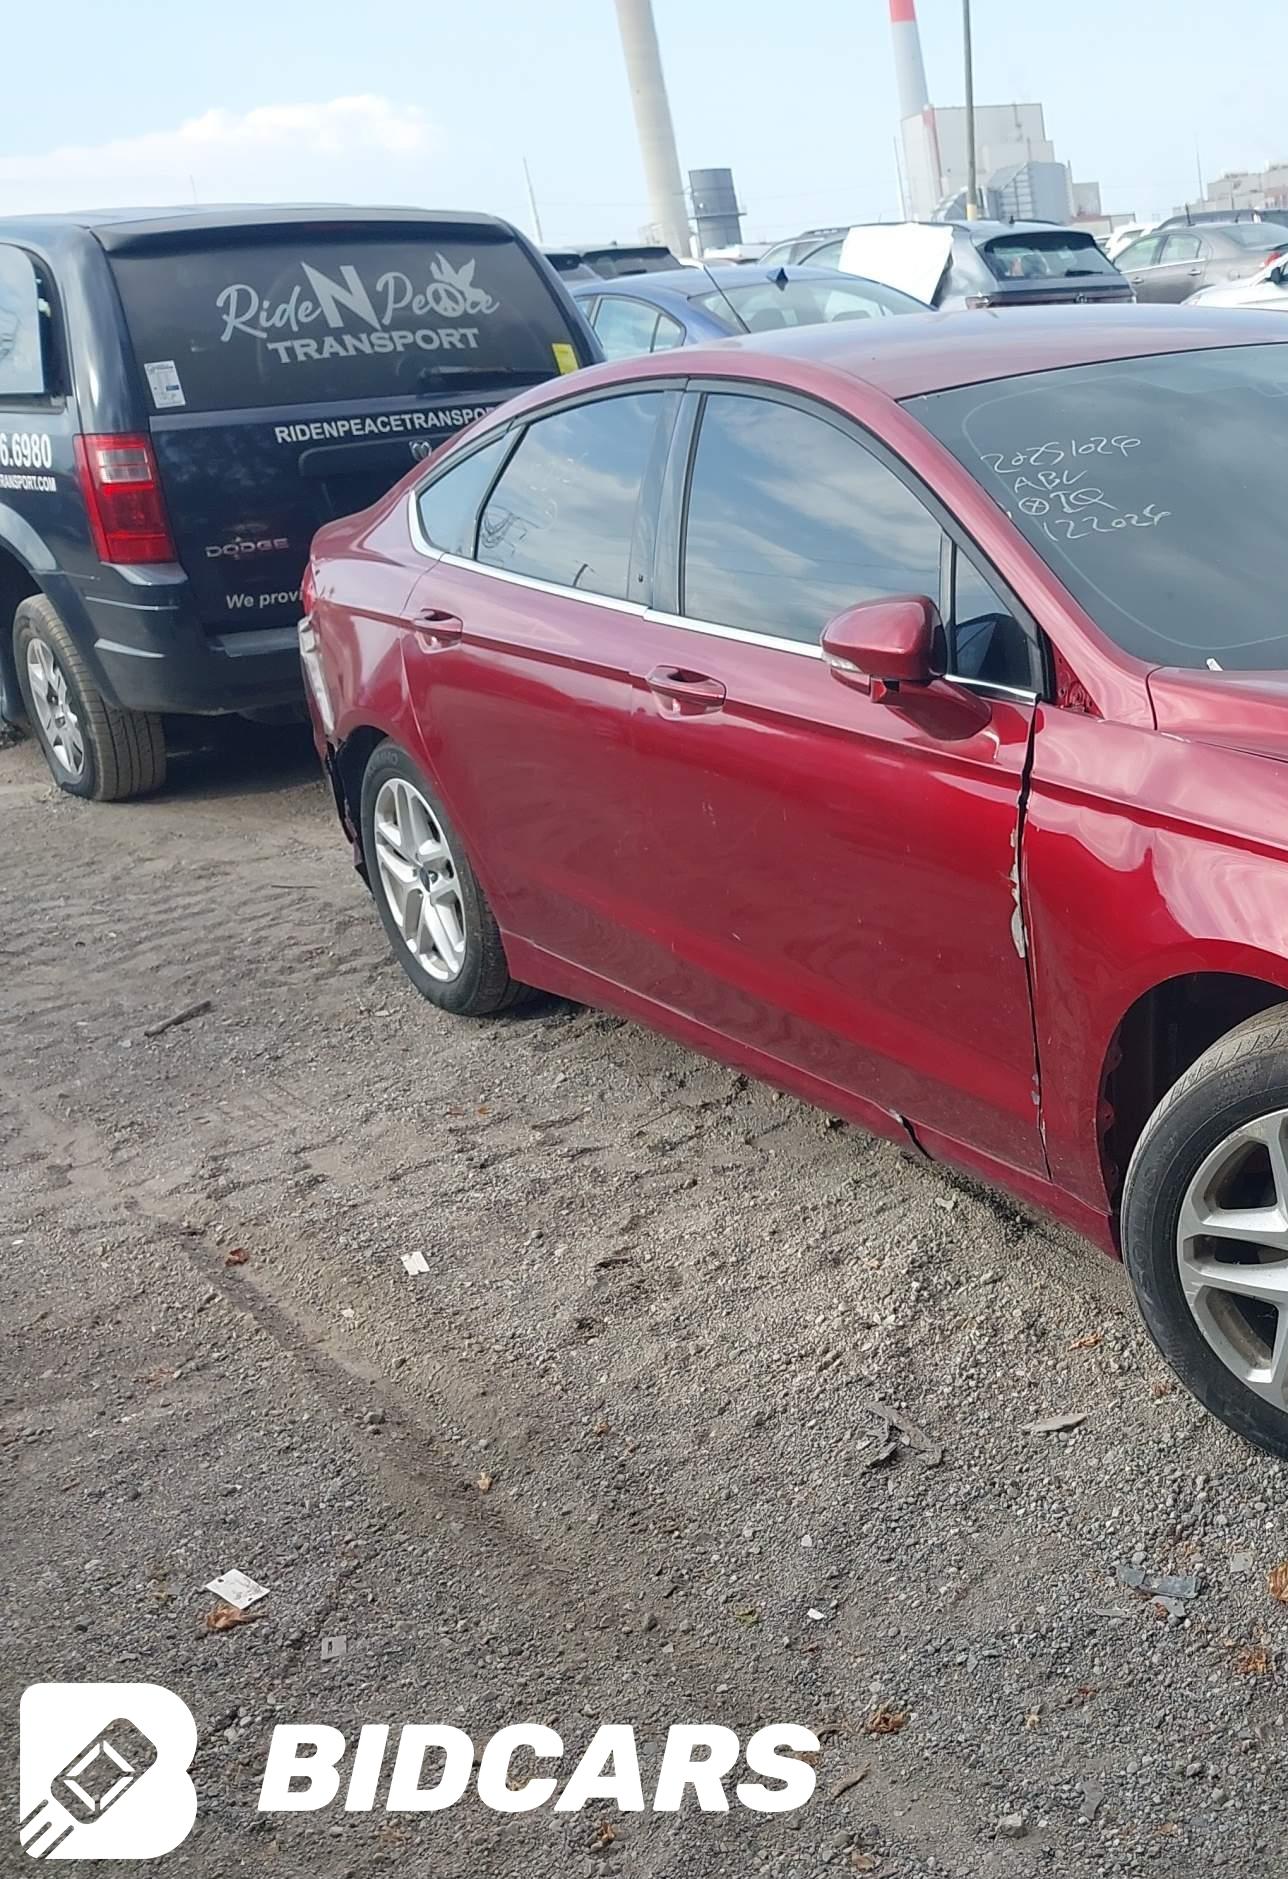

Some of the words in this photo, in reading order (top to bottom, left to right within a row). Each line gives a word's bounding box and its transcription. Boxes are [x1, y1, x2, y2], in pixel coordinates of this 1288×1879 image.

[216, 284, 322, 342] Ride
[301, 261, 382, 331] N
[267, 328, 480, 363] TRANSPORT
[205, 538, 289, 558] DODGE
[226, 593, 254, 609] We
